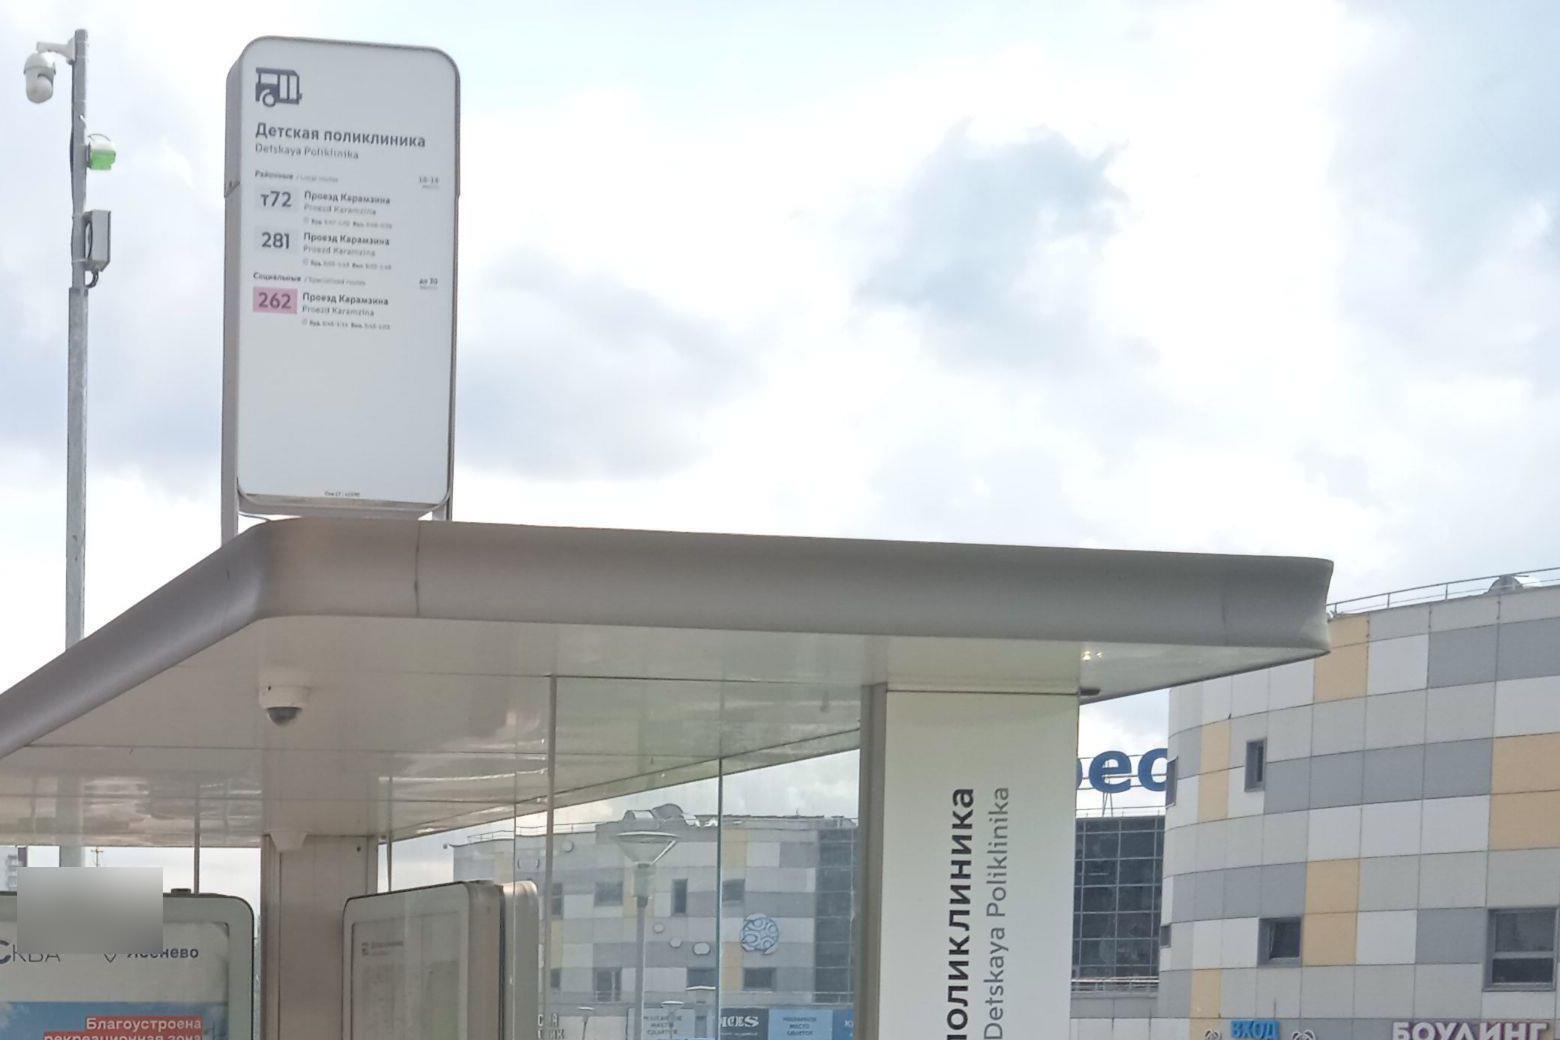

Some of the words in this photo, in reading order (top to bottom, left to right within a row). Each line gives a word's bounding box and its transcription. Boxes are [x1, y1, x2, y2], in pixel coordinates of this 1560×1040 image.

[255, 122, 319, 140] Детская
[324, 129, 426, 148] поликлиника
[255, 143, 301, 156] Detskaya
[304, 146, 359, 159] Poliklinika
[304, 190, 339, 202] Проезд
[340, 193, 391, 205] Карамзина
[261, 231, 290, 249] 281
[303, 232, 338, 244] Проезд
[340, 234, 390, 246] Карамзина
[258, 292, 292, 309] 262
[302, 292, 337, 304] Проезд
[338, 294, 389, 305] Карамзина
[986, 786, 1009, 918] Poliklinika
[127, 948, 199, 959] нево
[983, 927, 1009, 1040] Detskaya
[86, 1017, 201, 1032] Благоустроена
[1231, 1019, 1279, 1040] ВХОД
